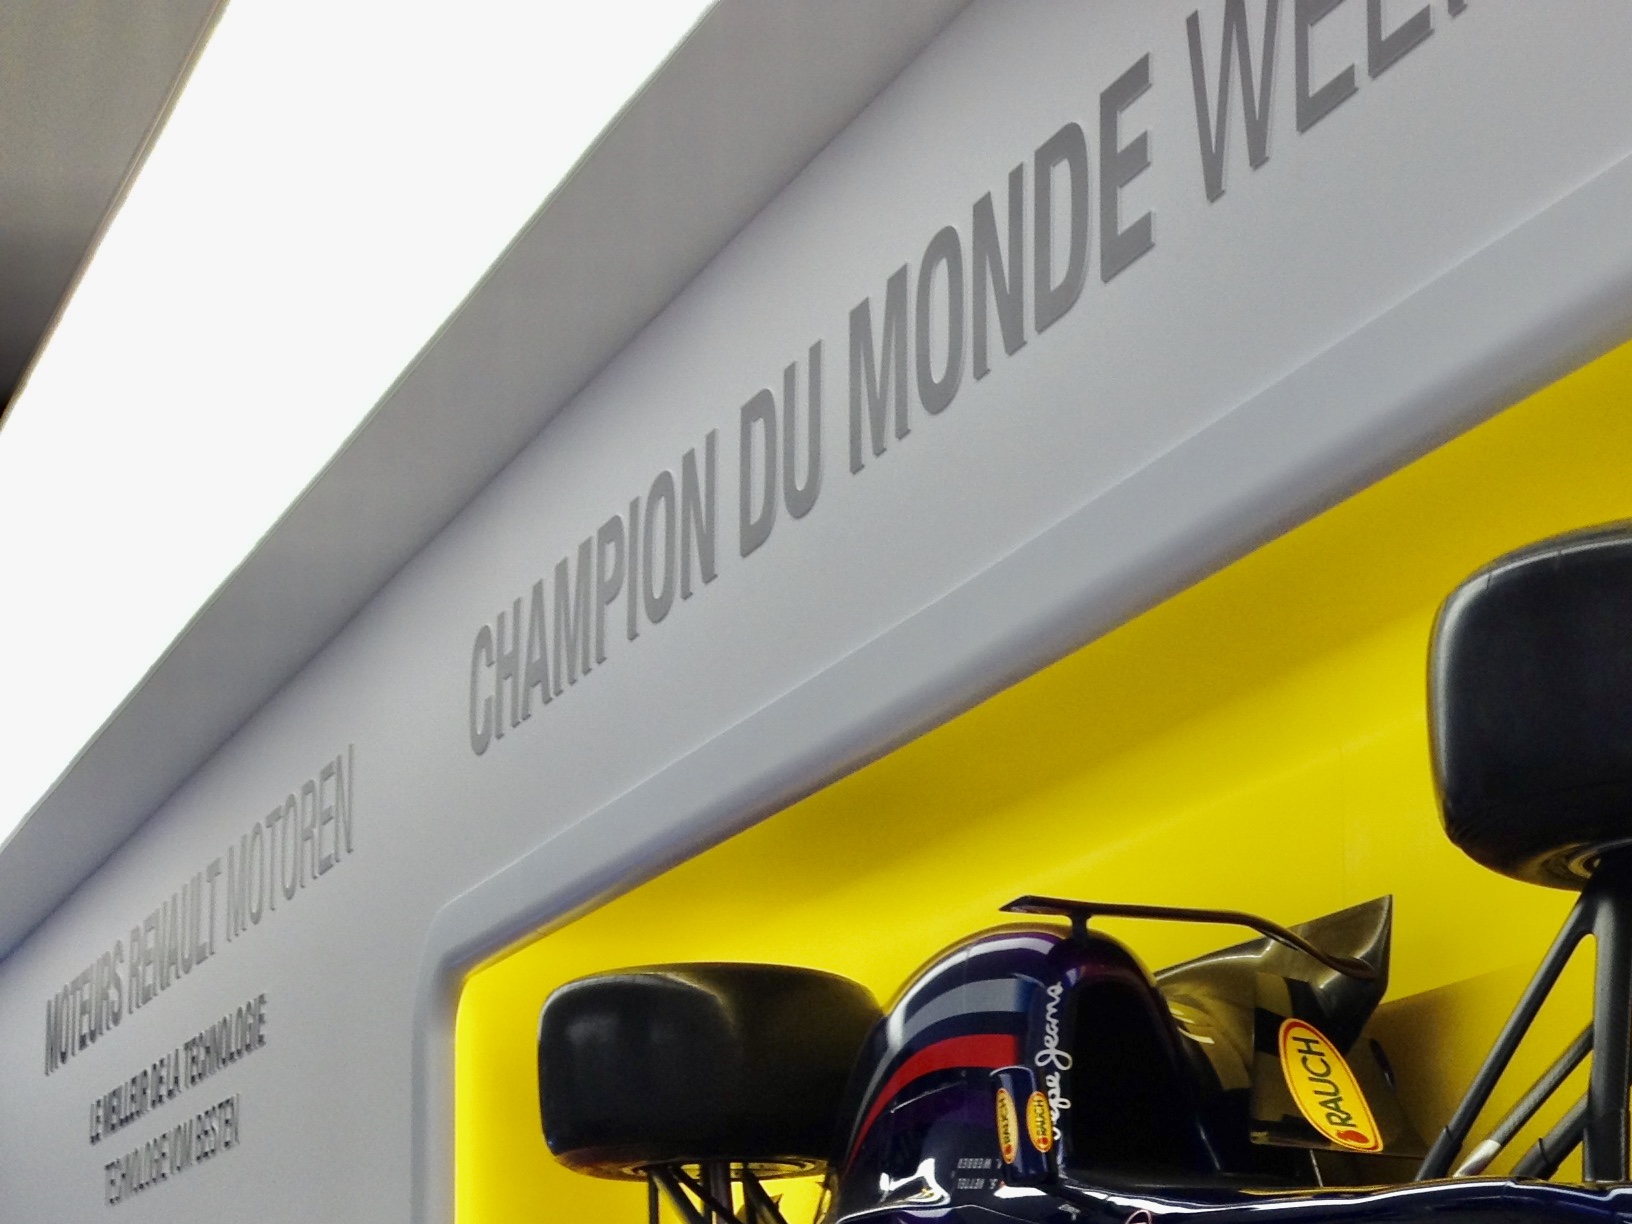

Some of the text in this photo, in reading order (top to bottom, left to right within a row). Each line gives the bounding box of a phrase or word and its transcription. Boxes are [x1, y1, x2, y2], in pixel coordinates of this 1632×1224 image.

[468, 0, 1468, 756] CHAMPION DU MONDE WEL
[45, 743, 354, 1077] MOTEURS RENAULT MOTOREN
[1034, 981, 1073, 1070] Jeans
[89, 1098, 101, 1145] LE
[166, 1048, 181, 1099] LA
[1034, 1098, 1047, 1137] RAUCH
[1291, 1036, 1358, 1129] RAUCH
